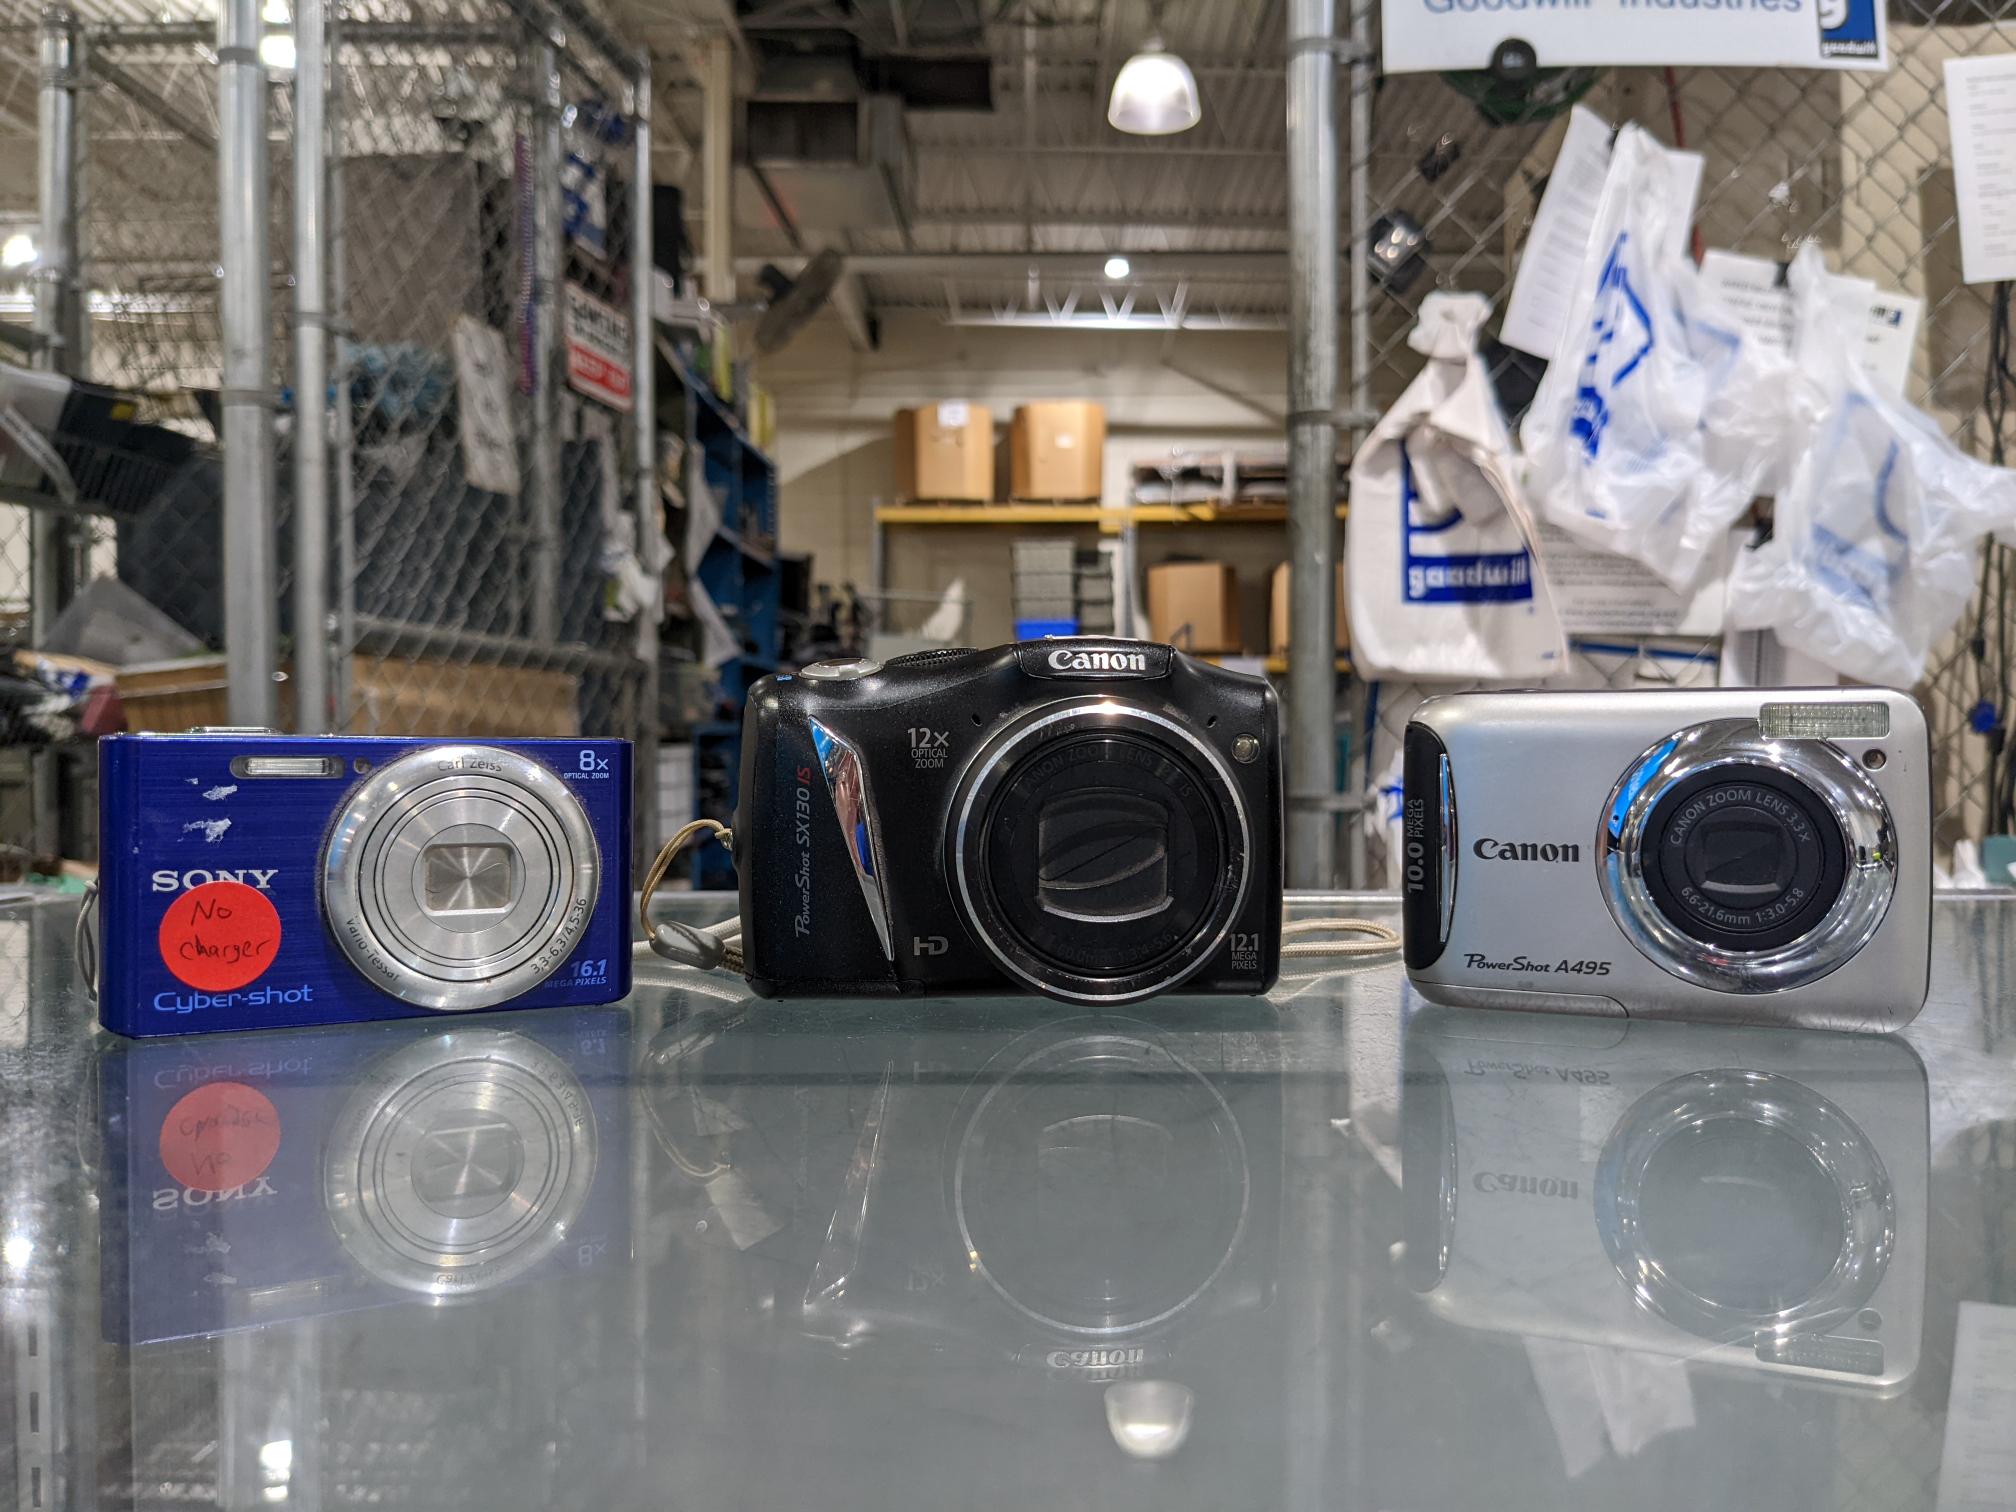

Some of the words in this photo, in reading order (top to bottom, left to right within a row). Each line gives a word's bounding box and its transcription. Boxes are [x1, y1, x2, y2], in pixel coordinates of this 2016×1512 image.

[1408, 558, 1526, 598] goodwill
[1048, 650, 1146, 670] Canon
[907, 727, 950, 748] 12x
[437, 757, 465, 771] Carl
[470, 758, 502, 772] Zeiss
[579, 750, 609, 771] 8x
[911, 748, 948, 759] OPTICAL
[915, 758, 944, 769] ZOOM
[563, 772, 589, 780] OPTICAL
[796, 767, 813, 785] IS
[796, 788, 810, 846] SX130
[1407, 800, 1415, 837] MEGA
[1414, 799, 1424, 838] PIXELS
[1670, 802, 1707, 845] CANON
[1706, 789, 1752, 807] ZOOM
[1755, 792, 1790, 815] LENS
[1473, 838, 1580, 863] Canon
[1407, 842, 1424, 893] 10.0
[152, 869, 279, 892] SONY
[795, 851, 811, 937] PowerShot
[190, 898, 233, 926] No
[1681, 887, 1750, 925] 6.6-21.6mm
[1755, 888, 1804, 923] 1:3.0-5.8
[179, 934, 272, 964] charger
[346, 916, 400, 981] Vario-Tessar
[913, 936, 949, 956] HD
[1231, 933, 1259, 951] 12.1
[1231, 951, 1257, 961] MEGA
[1231, 960, 1257, 970] PIXELS
[1464, 954, 1550, 972] PowerShot
[1554, 960, 1612, 976] A495
[570, 959, 607, 978] 16.1
[544, 979, 573, 989] MEGA
[574, 976, 607, 986] PIXELS
[154, 984, 313, 1014] Cyber-shot
